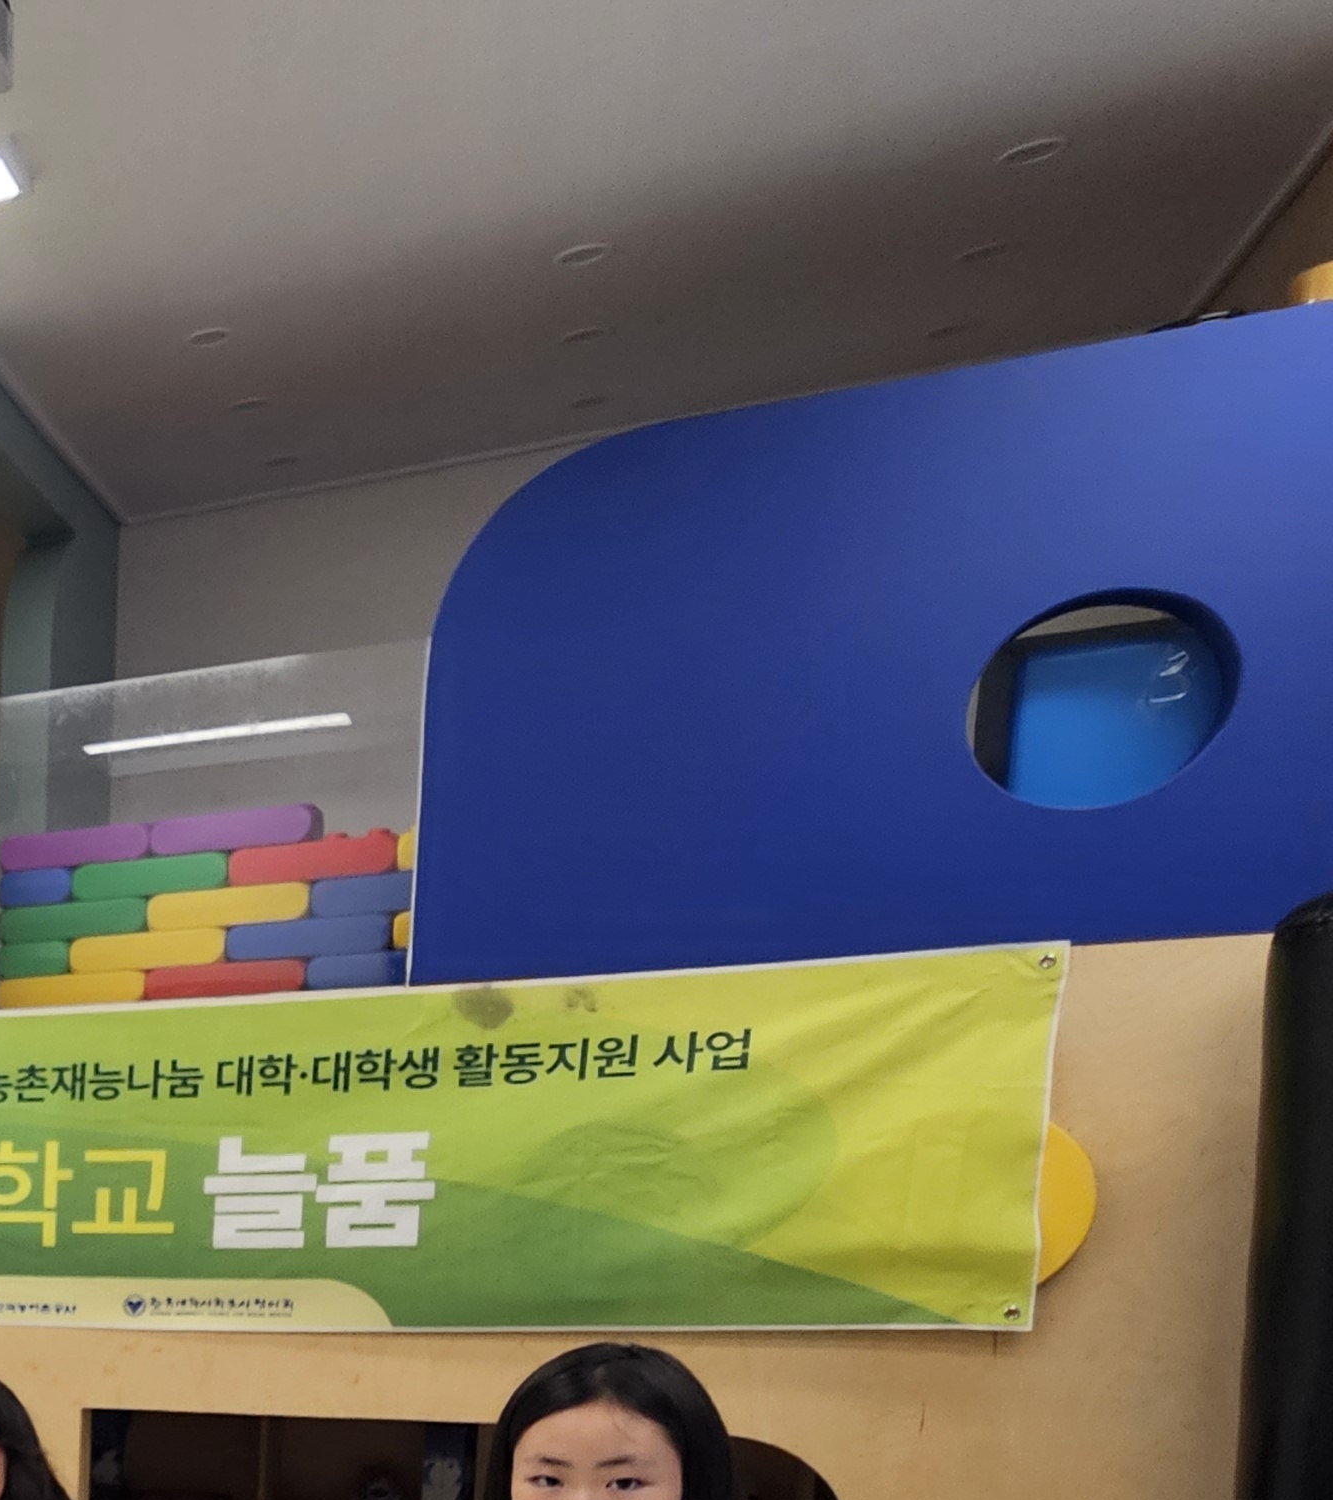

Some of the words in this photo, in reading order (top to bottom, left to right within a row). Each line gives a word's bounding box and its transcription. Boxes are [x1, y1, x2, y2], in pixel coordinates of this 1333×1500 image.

[217, 1046, 440, 1096] 대학·대학생
[453, 1034, 639, 1088] 활동지원
[653, 1028, 752, 1074] 사업
[203, 1131, 435, 1250] 늘품
